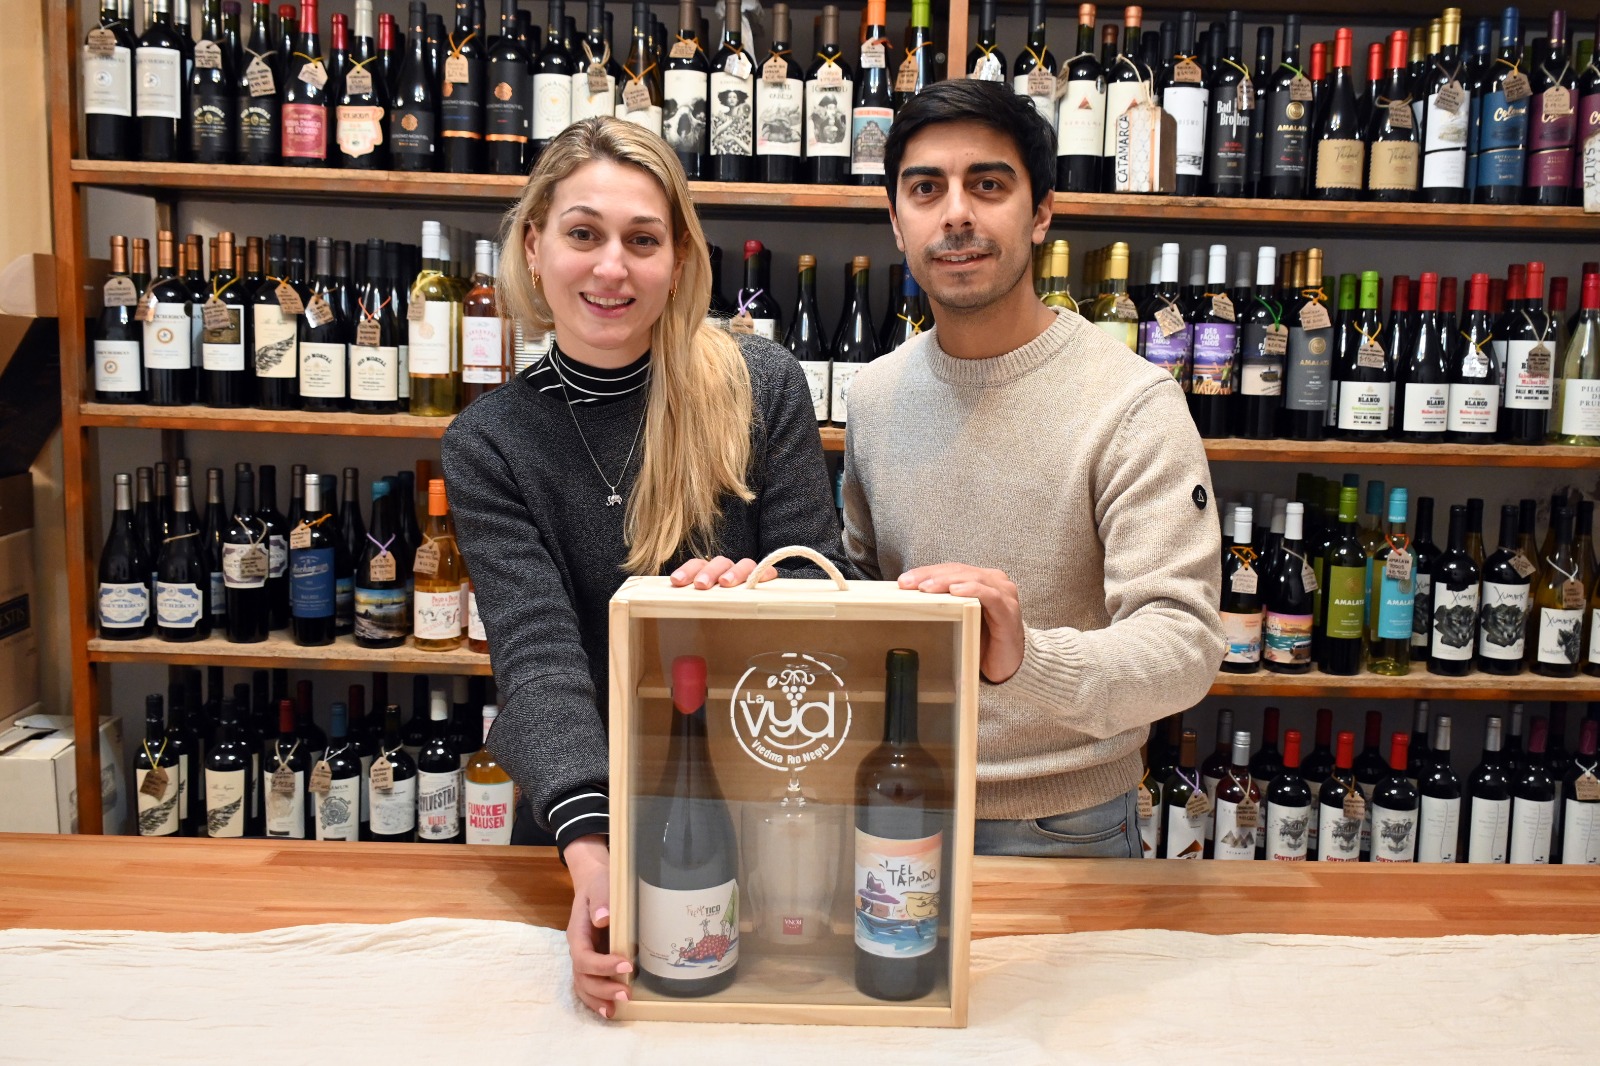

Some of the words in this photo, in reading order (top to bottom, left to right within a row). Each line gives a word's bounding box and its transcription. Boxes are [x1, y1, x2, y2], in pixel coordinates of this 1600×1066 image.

[1217, 100, 1231, 113] Bad
[1117, 113, 1130, 184] CATAMARCA
[1584, 148, 1596, 189] SALTA
[746, 691, 764, 704] La
[751, 739, 784, 763] Viedma
[802, 742, 830, 762] Negro
[886, 868, 937, 887] TAPADO
[900, 864, 912, 875] EL
